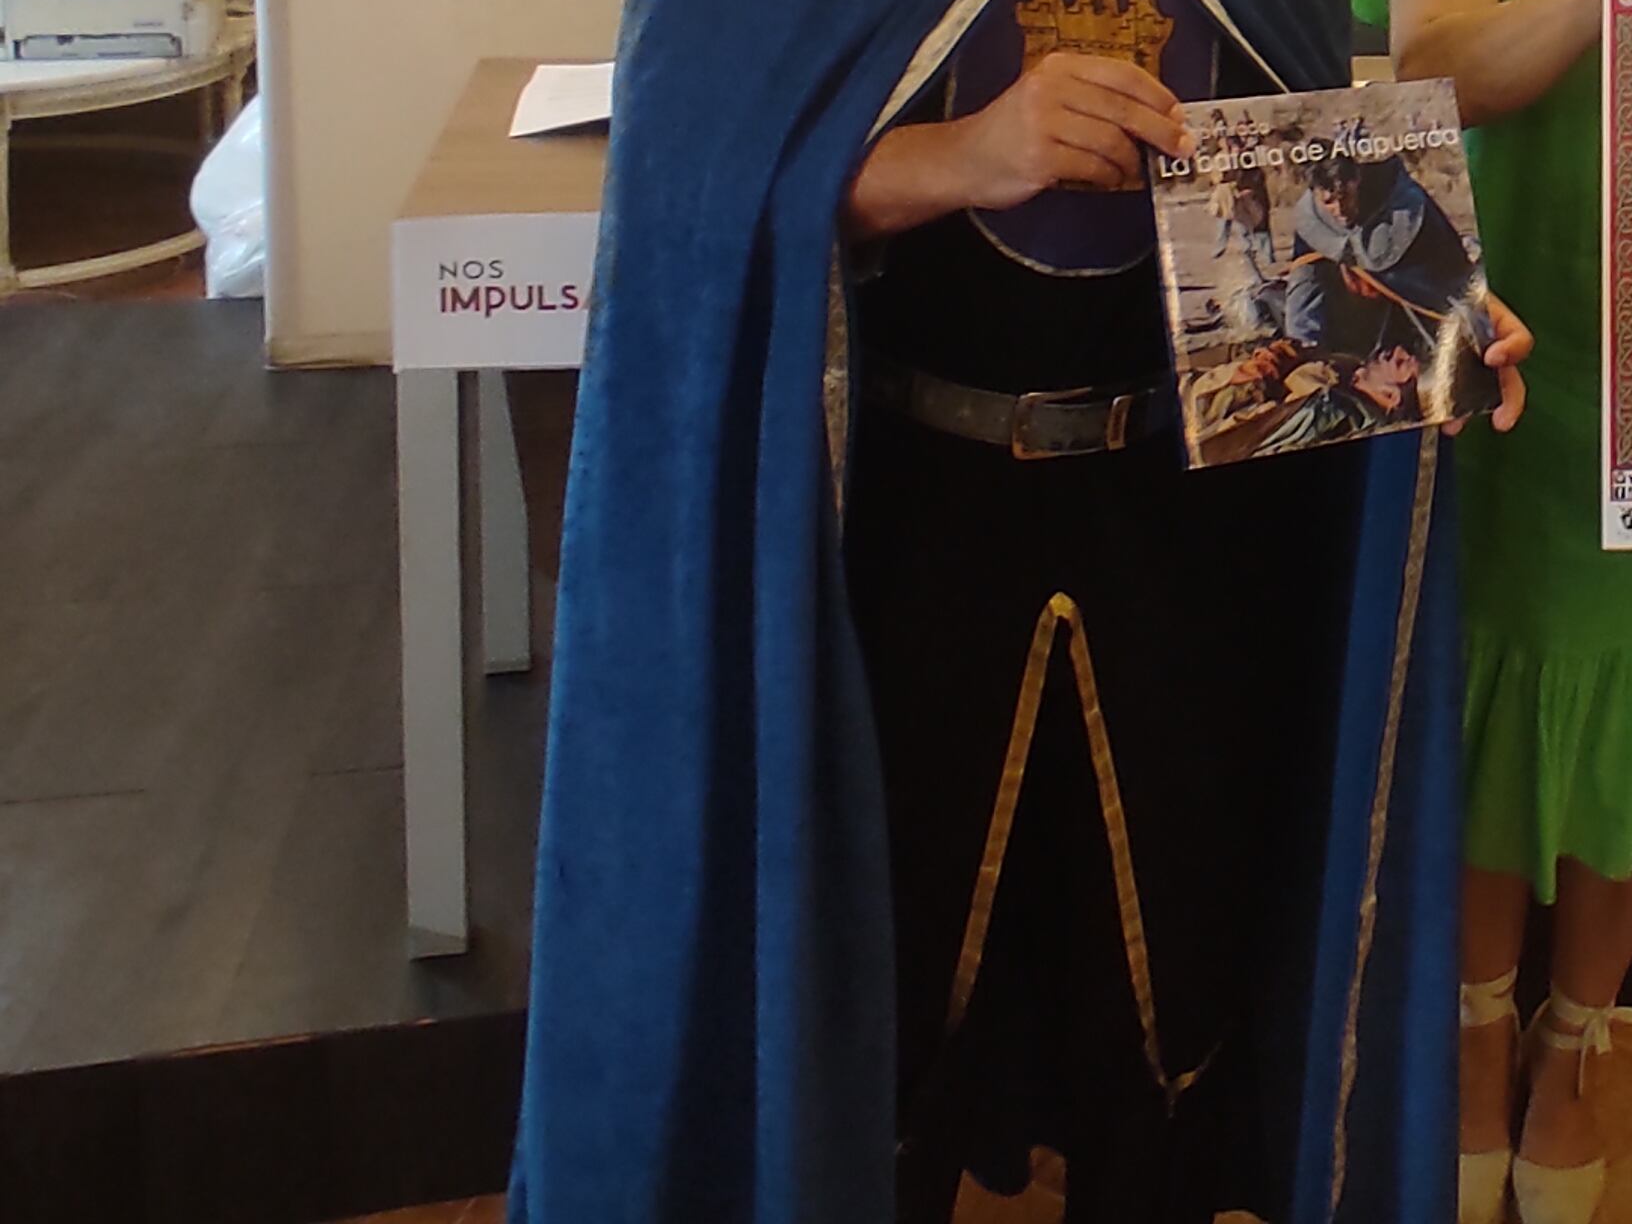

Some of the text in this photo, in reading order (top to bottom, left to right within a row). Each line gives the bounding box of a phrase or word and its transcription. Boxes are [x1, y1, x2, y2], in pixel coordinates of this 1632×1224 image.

[1158, 155, 1191, 178] La
[1290, 142, 1326, 164] de
[1329, 127, 1460, 160] Atapuerca
[438, 260, 504, 280] NOS
[440, 284, 588, 319] IMPULS
